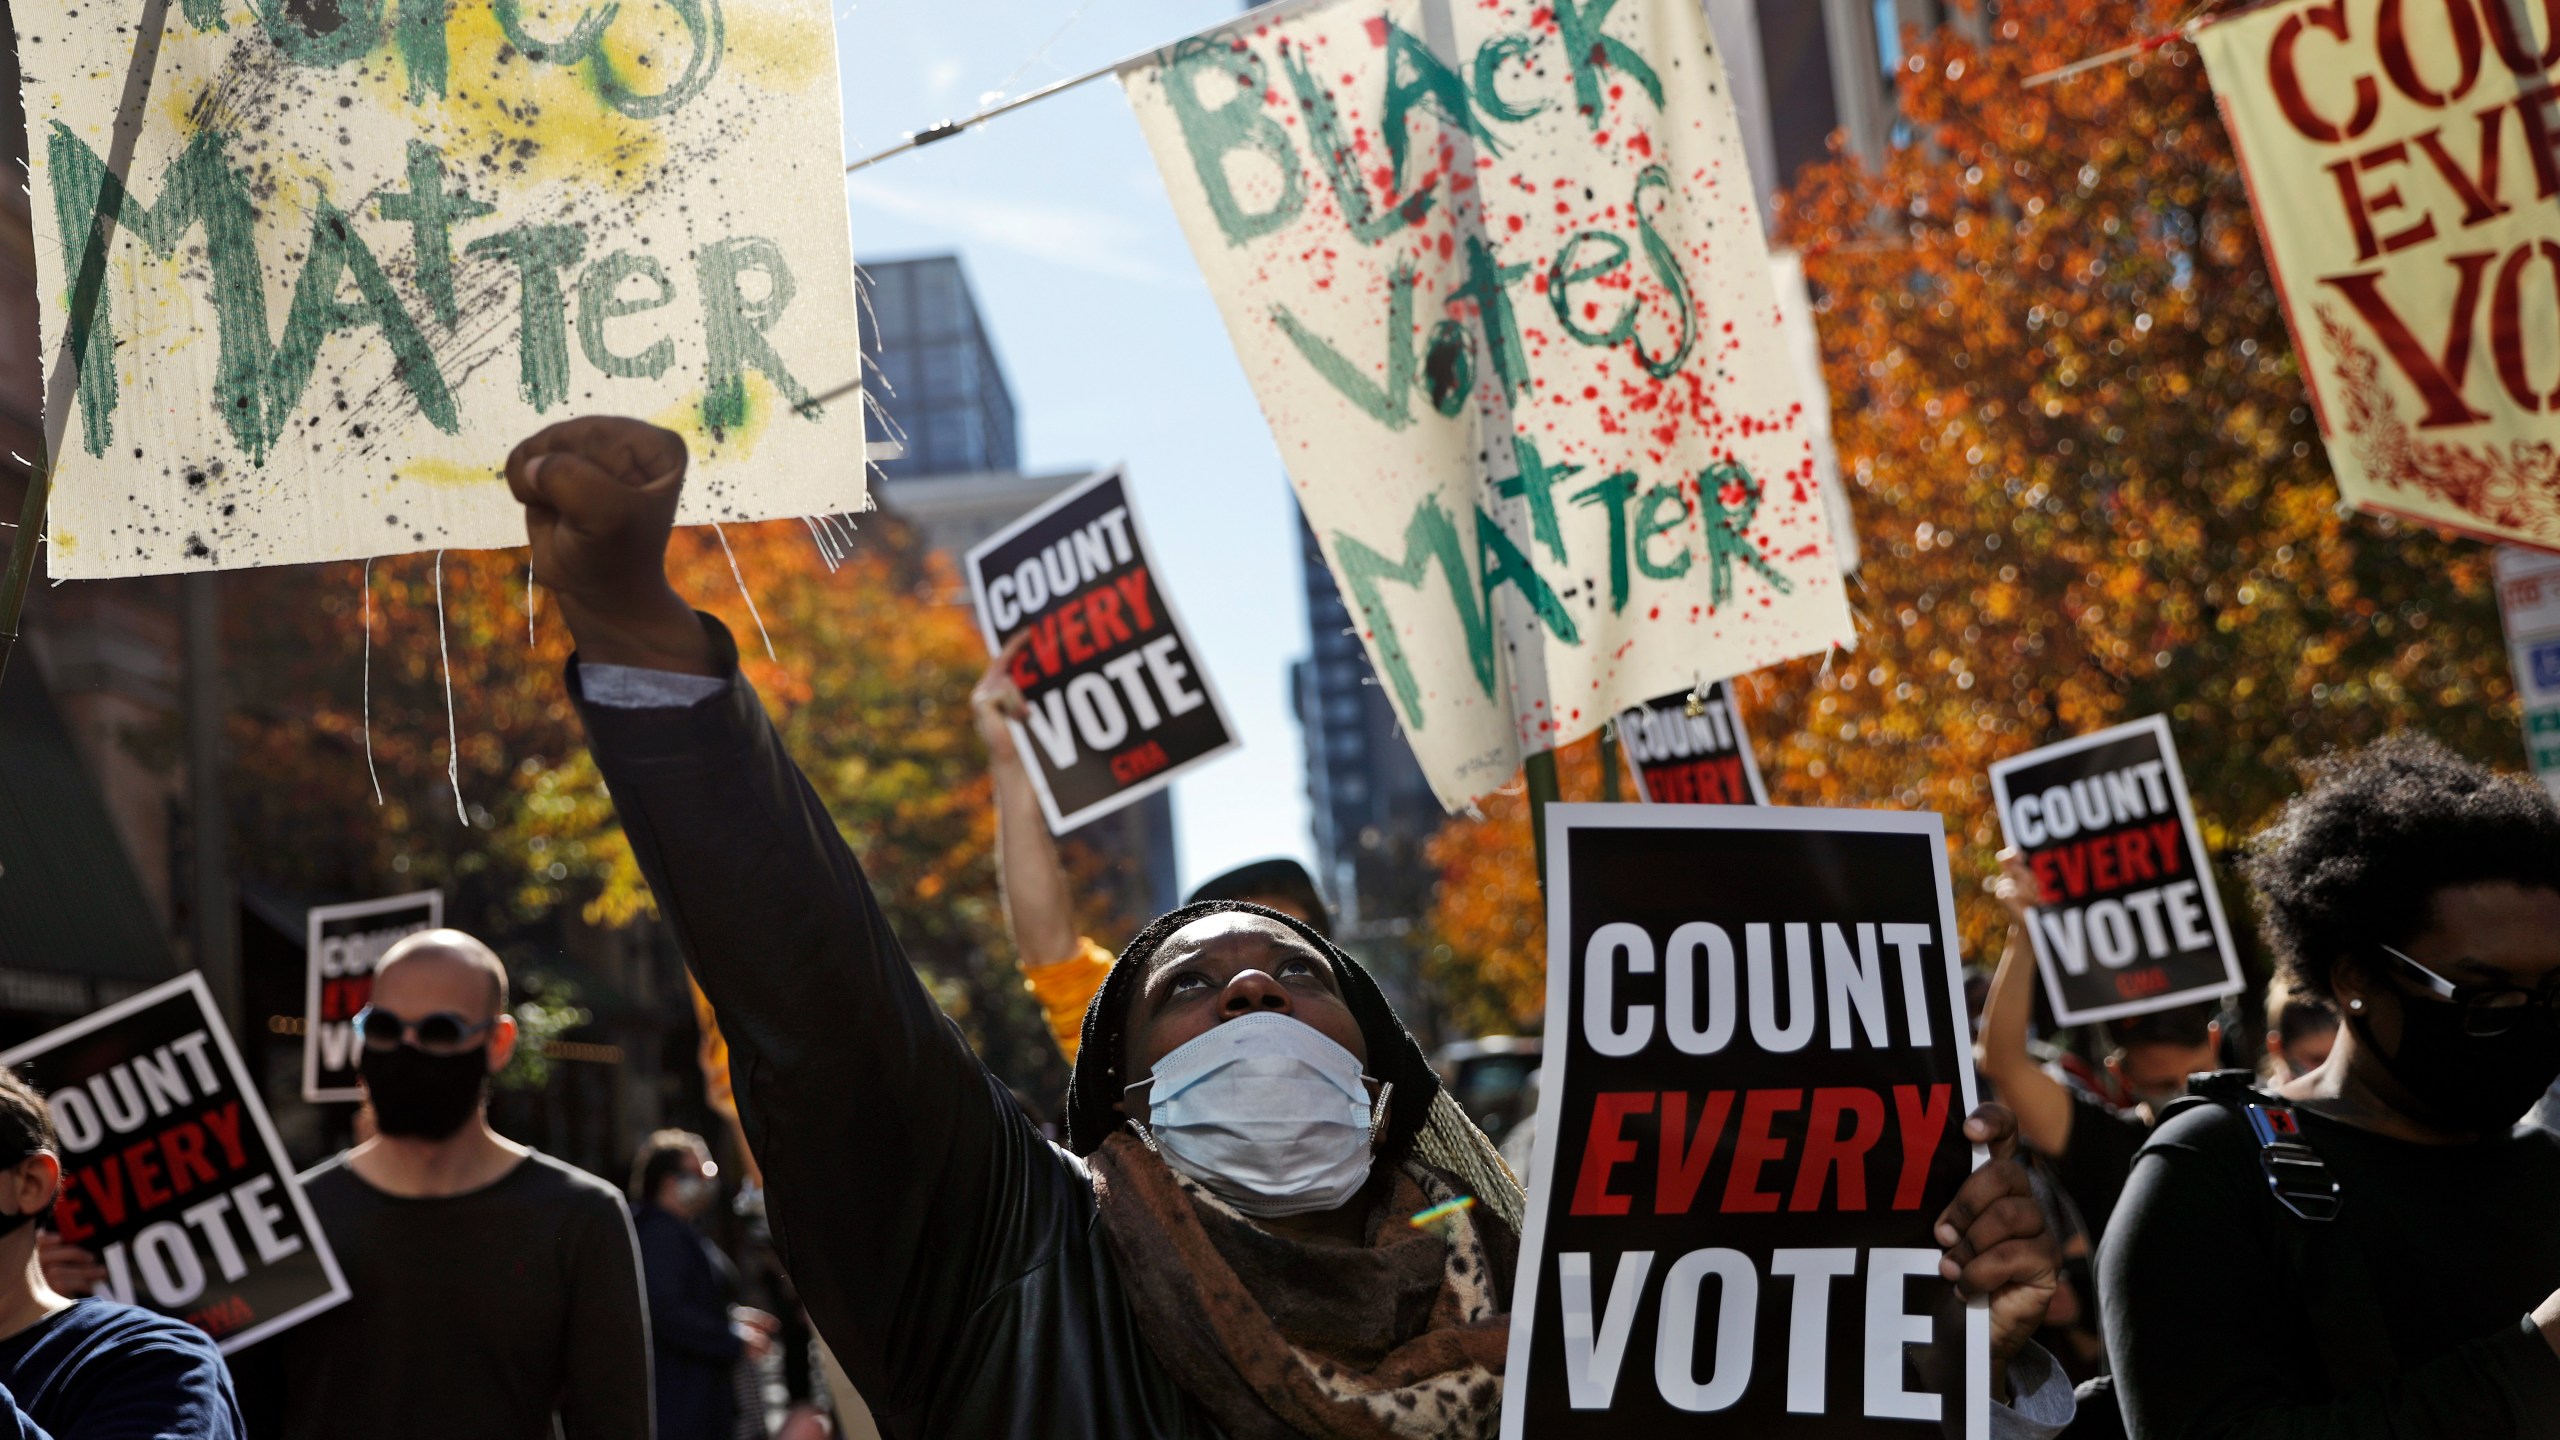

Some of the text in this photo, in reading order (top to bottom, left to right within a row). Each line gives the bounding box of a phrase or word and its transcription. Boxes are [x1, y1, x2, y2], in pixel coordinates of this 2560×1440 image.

[988, 505, 1134, 632] COUNT
[1010, 567, 1156, 690] EVERY
[1028, 633, 1205, 770] VOTE
[2011, 759, 2170, 848] COUNT
[2029, 818, 2183, 905] EVERY
[1583, 921, 1933, 1057] COUNT
[2041, 879, 2216, 976] VOTE
[50, 1028, 222, 1154] OUNT
[1569, 1084, 1952, 1216] EVERY
[53, 1100, 248, 1242] EVERY
[1558, 1247, 1943, 1422] VOTE
